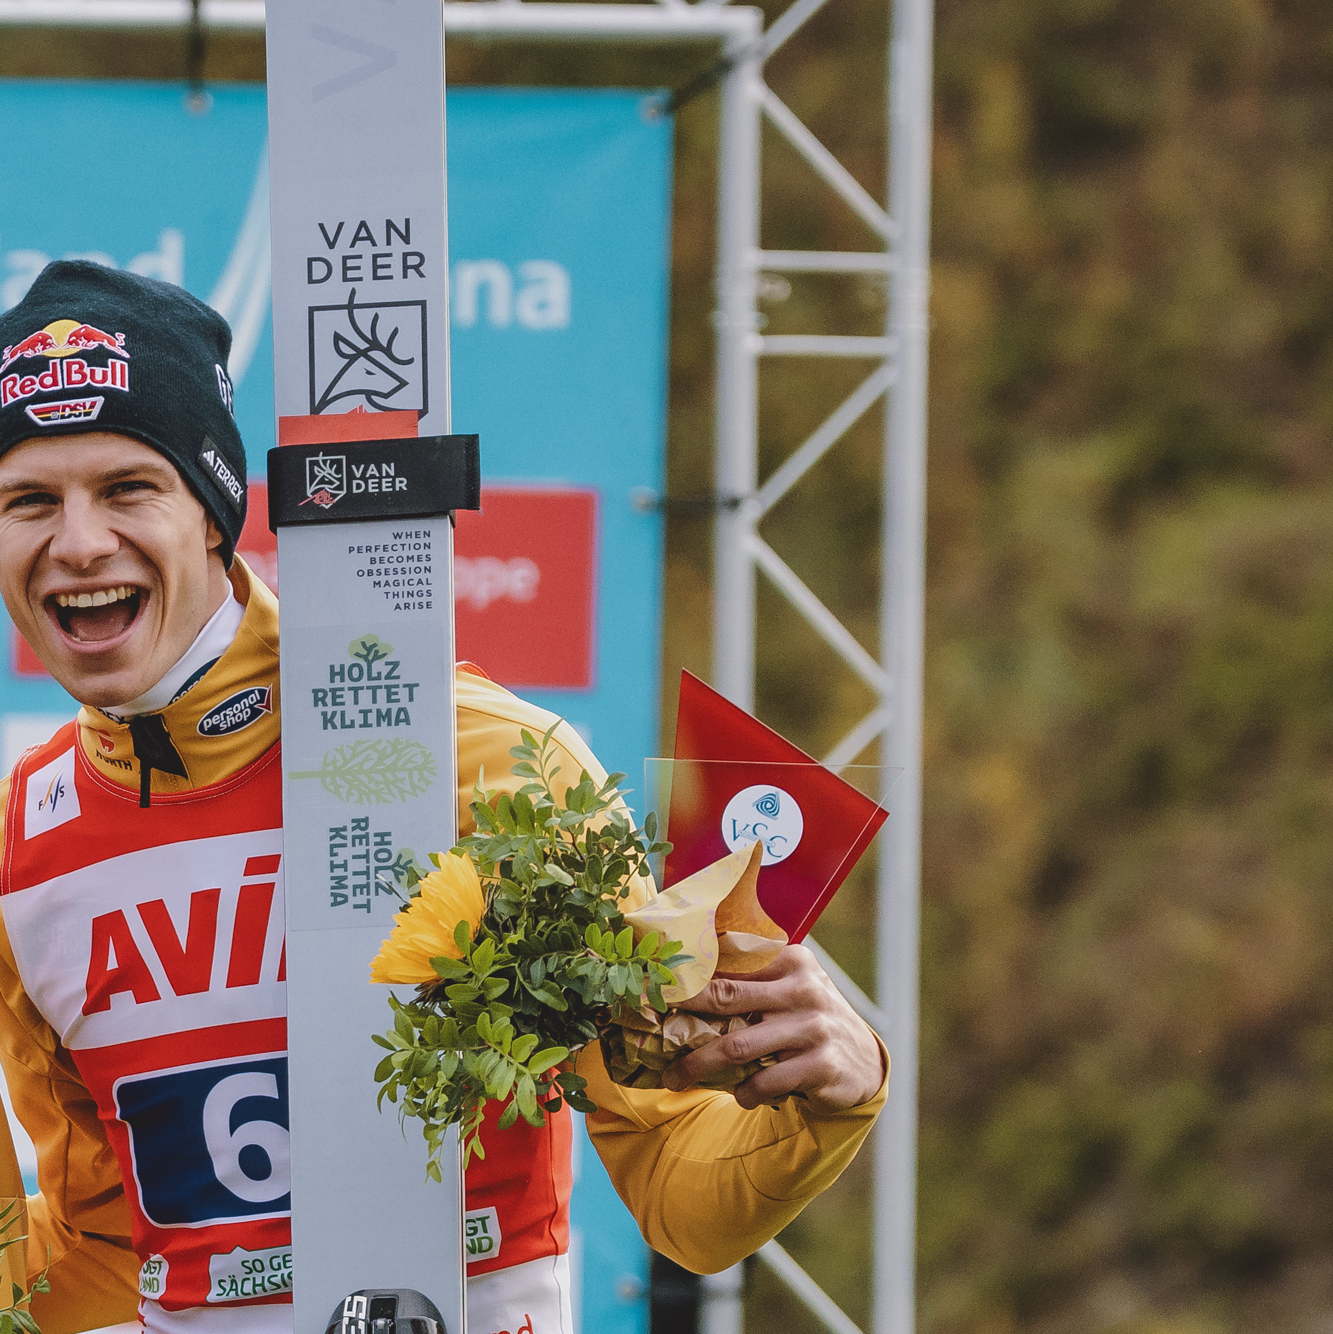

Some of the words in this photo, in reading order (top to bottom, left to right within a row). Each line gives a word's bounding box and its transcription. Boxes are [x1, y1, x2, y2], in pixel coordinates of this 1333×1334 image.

[318, 218, 411, 249] VAN
[307, 252, 426, 284] DEER
[0, 359, 62, 407] Red
[63, 358, 129, 392] Bull
[62, 401, 94, 420] DSV
[213, 457, 243, 503] TERREX
[351, 462, 396, 479] VAN
[351, 477, 408, 494] DEER
[392, 530, 431, 540] WHEN
[348, 542, 431, 554] PERFECTION
[369, 554, 432, 565] BECOMES
[356, 566, 432, 577] OBSESSION
[373, 577, 433, 588] MAGICAL
[384, 589, 433, 600] THINGS
[394, 601, 433, 611] ARISE
[329, 660, 401, 684] HOLZ
[312, 682, 420, 708] RETTET
[203, 691, 261, 739] personal
[219, 709, 252, 733] shop
[321, 706, 411, 731] KLIMA
[38, 784, 66, 811] FIS
[329, 825, 349, 908] KLIMA
[351, 816, 372, 914] RETTET
[373, 831, 394, 896] HOLZ
[202, 1071, 293, 1204] 6
[241, 1257, 266, 1276] SO
